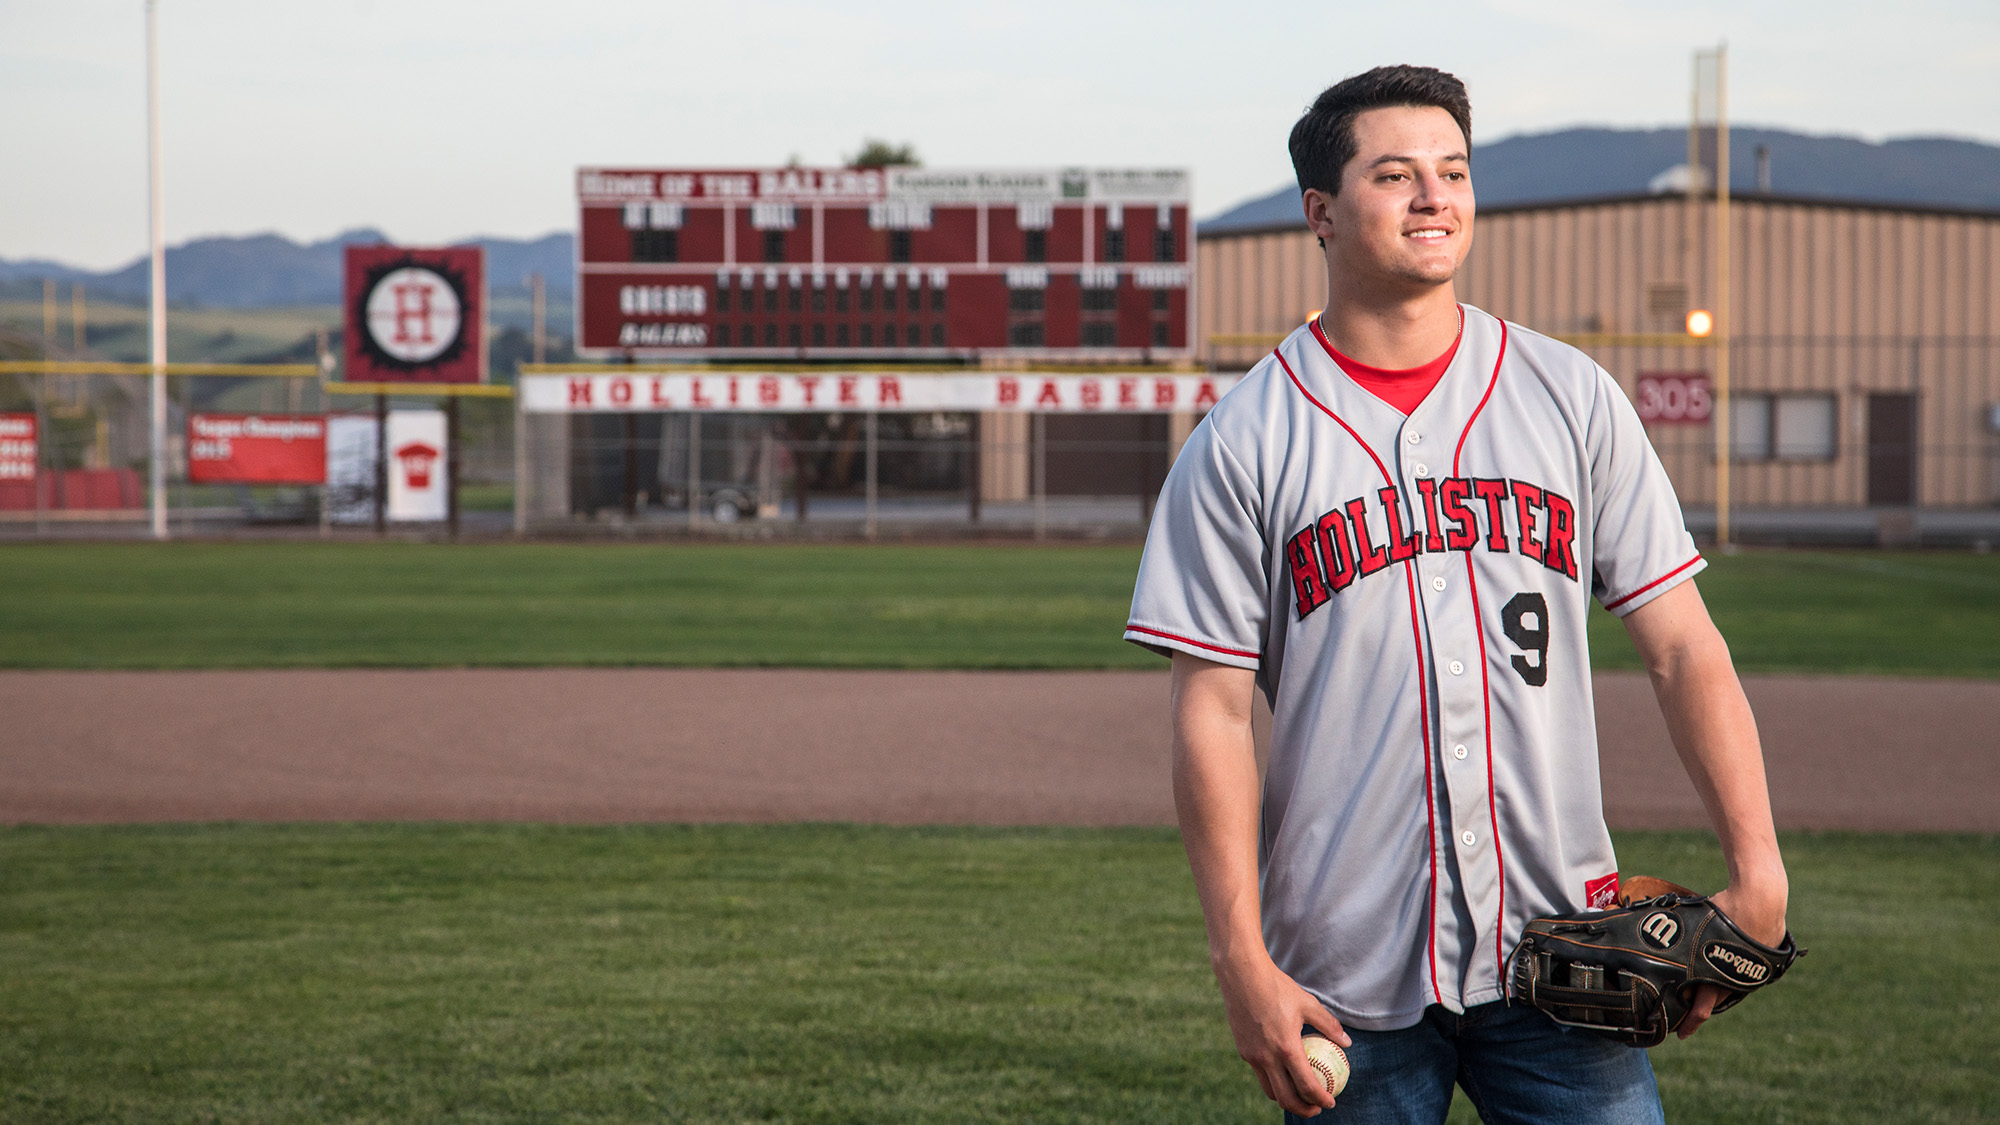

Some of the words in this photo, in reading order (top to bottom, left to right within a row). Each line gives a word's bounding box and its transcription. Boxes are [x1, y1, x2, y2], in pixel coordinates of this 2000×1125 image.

[582, 173, 655, 197] HOME
[660, 173, 693, 197] OF
[702, 173, 751, 197] THE
[757, 170, 881, 197] BALERS
[391, 283, 437, 345] H
[620, 285, 707, 316] GUESTS
[619, 322, 708, 347] BALERS
[567, 376, 904, 408] HOLLISTER
[999, 375, 1246, 409] BASEBA
[1636, 376, 1713, 421] 305
[1286, 476, 1579, 623] HOLLISTER
[1501, 592, 1549, 687] 9
[1712, 944, 1767, 980] Wilson
